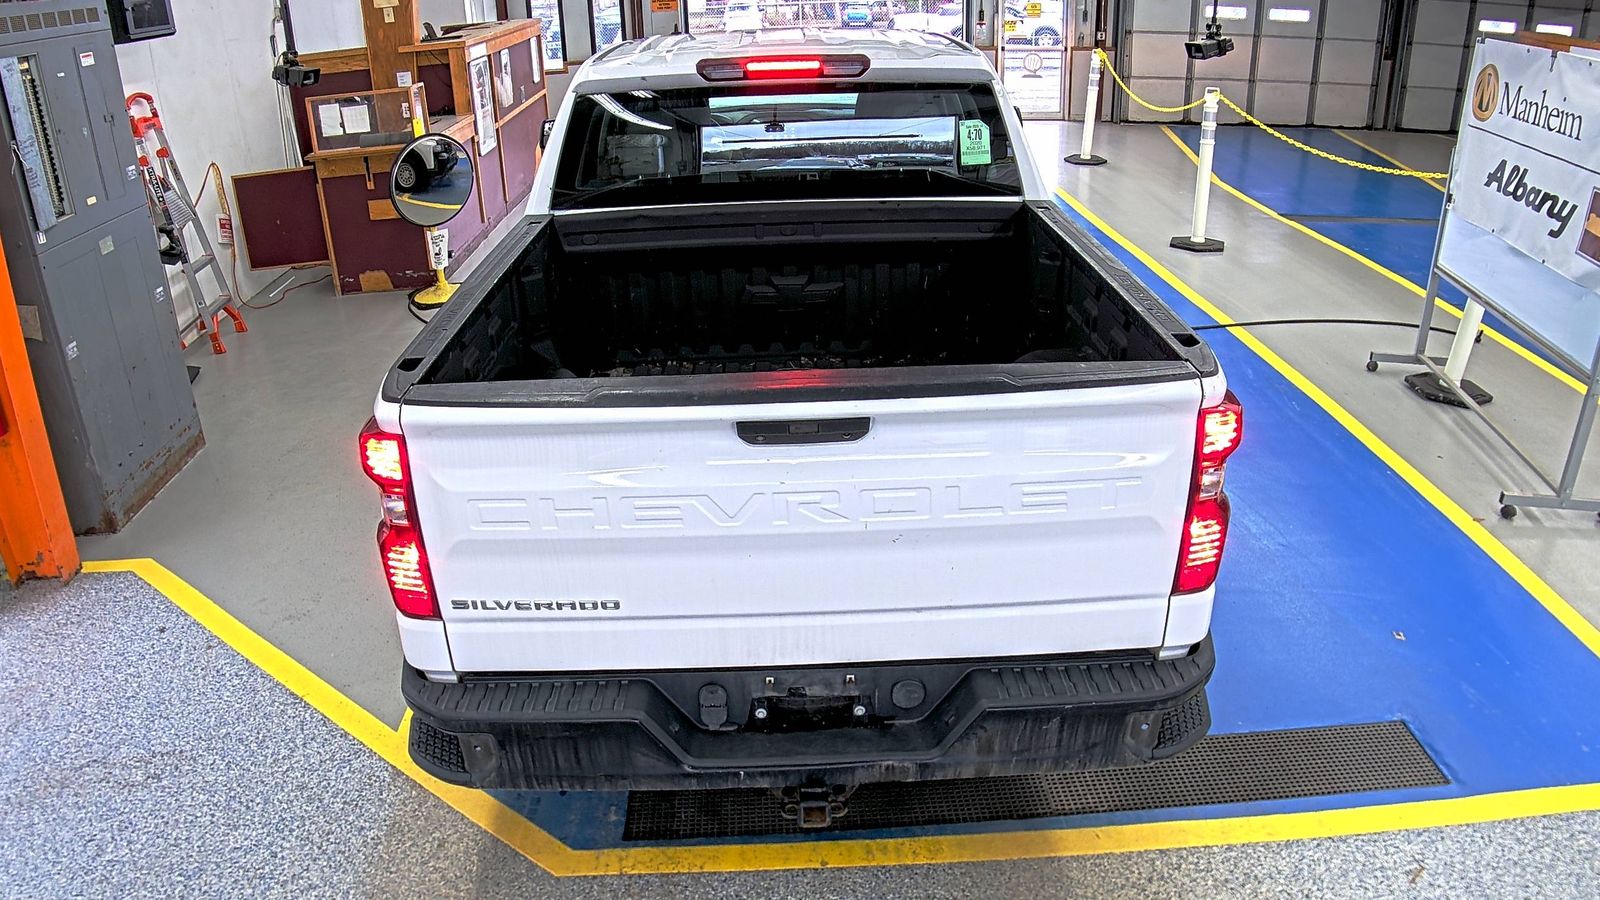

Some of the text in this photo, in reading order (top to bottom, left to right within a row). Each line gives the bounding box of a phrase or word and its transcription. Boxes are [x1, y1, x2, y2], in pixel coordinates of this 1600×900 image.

[967, 128, 983, 141] 4:70
[1499, 81, 1583, 141] Manheim
[1484, 158, 1579, 240] Albany
[467, 476, 1143, 532] CHEVROLET
[450, 598, 621, 612] SILVERADO
